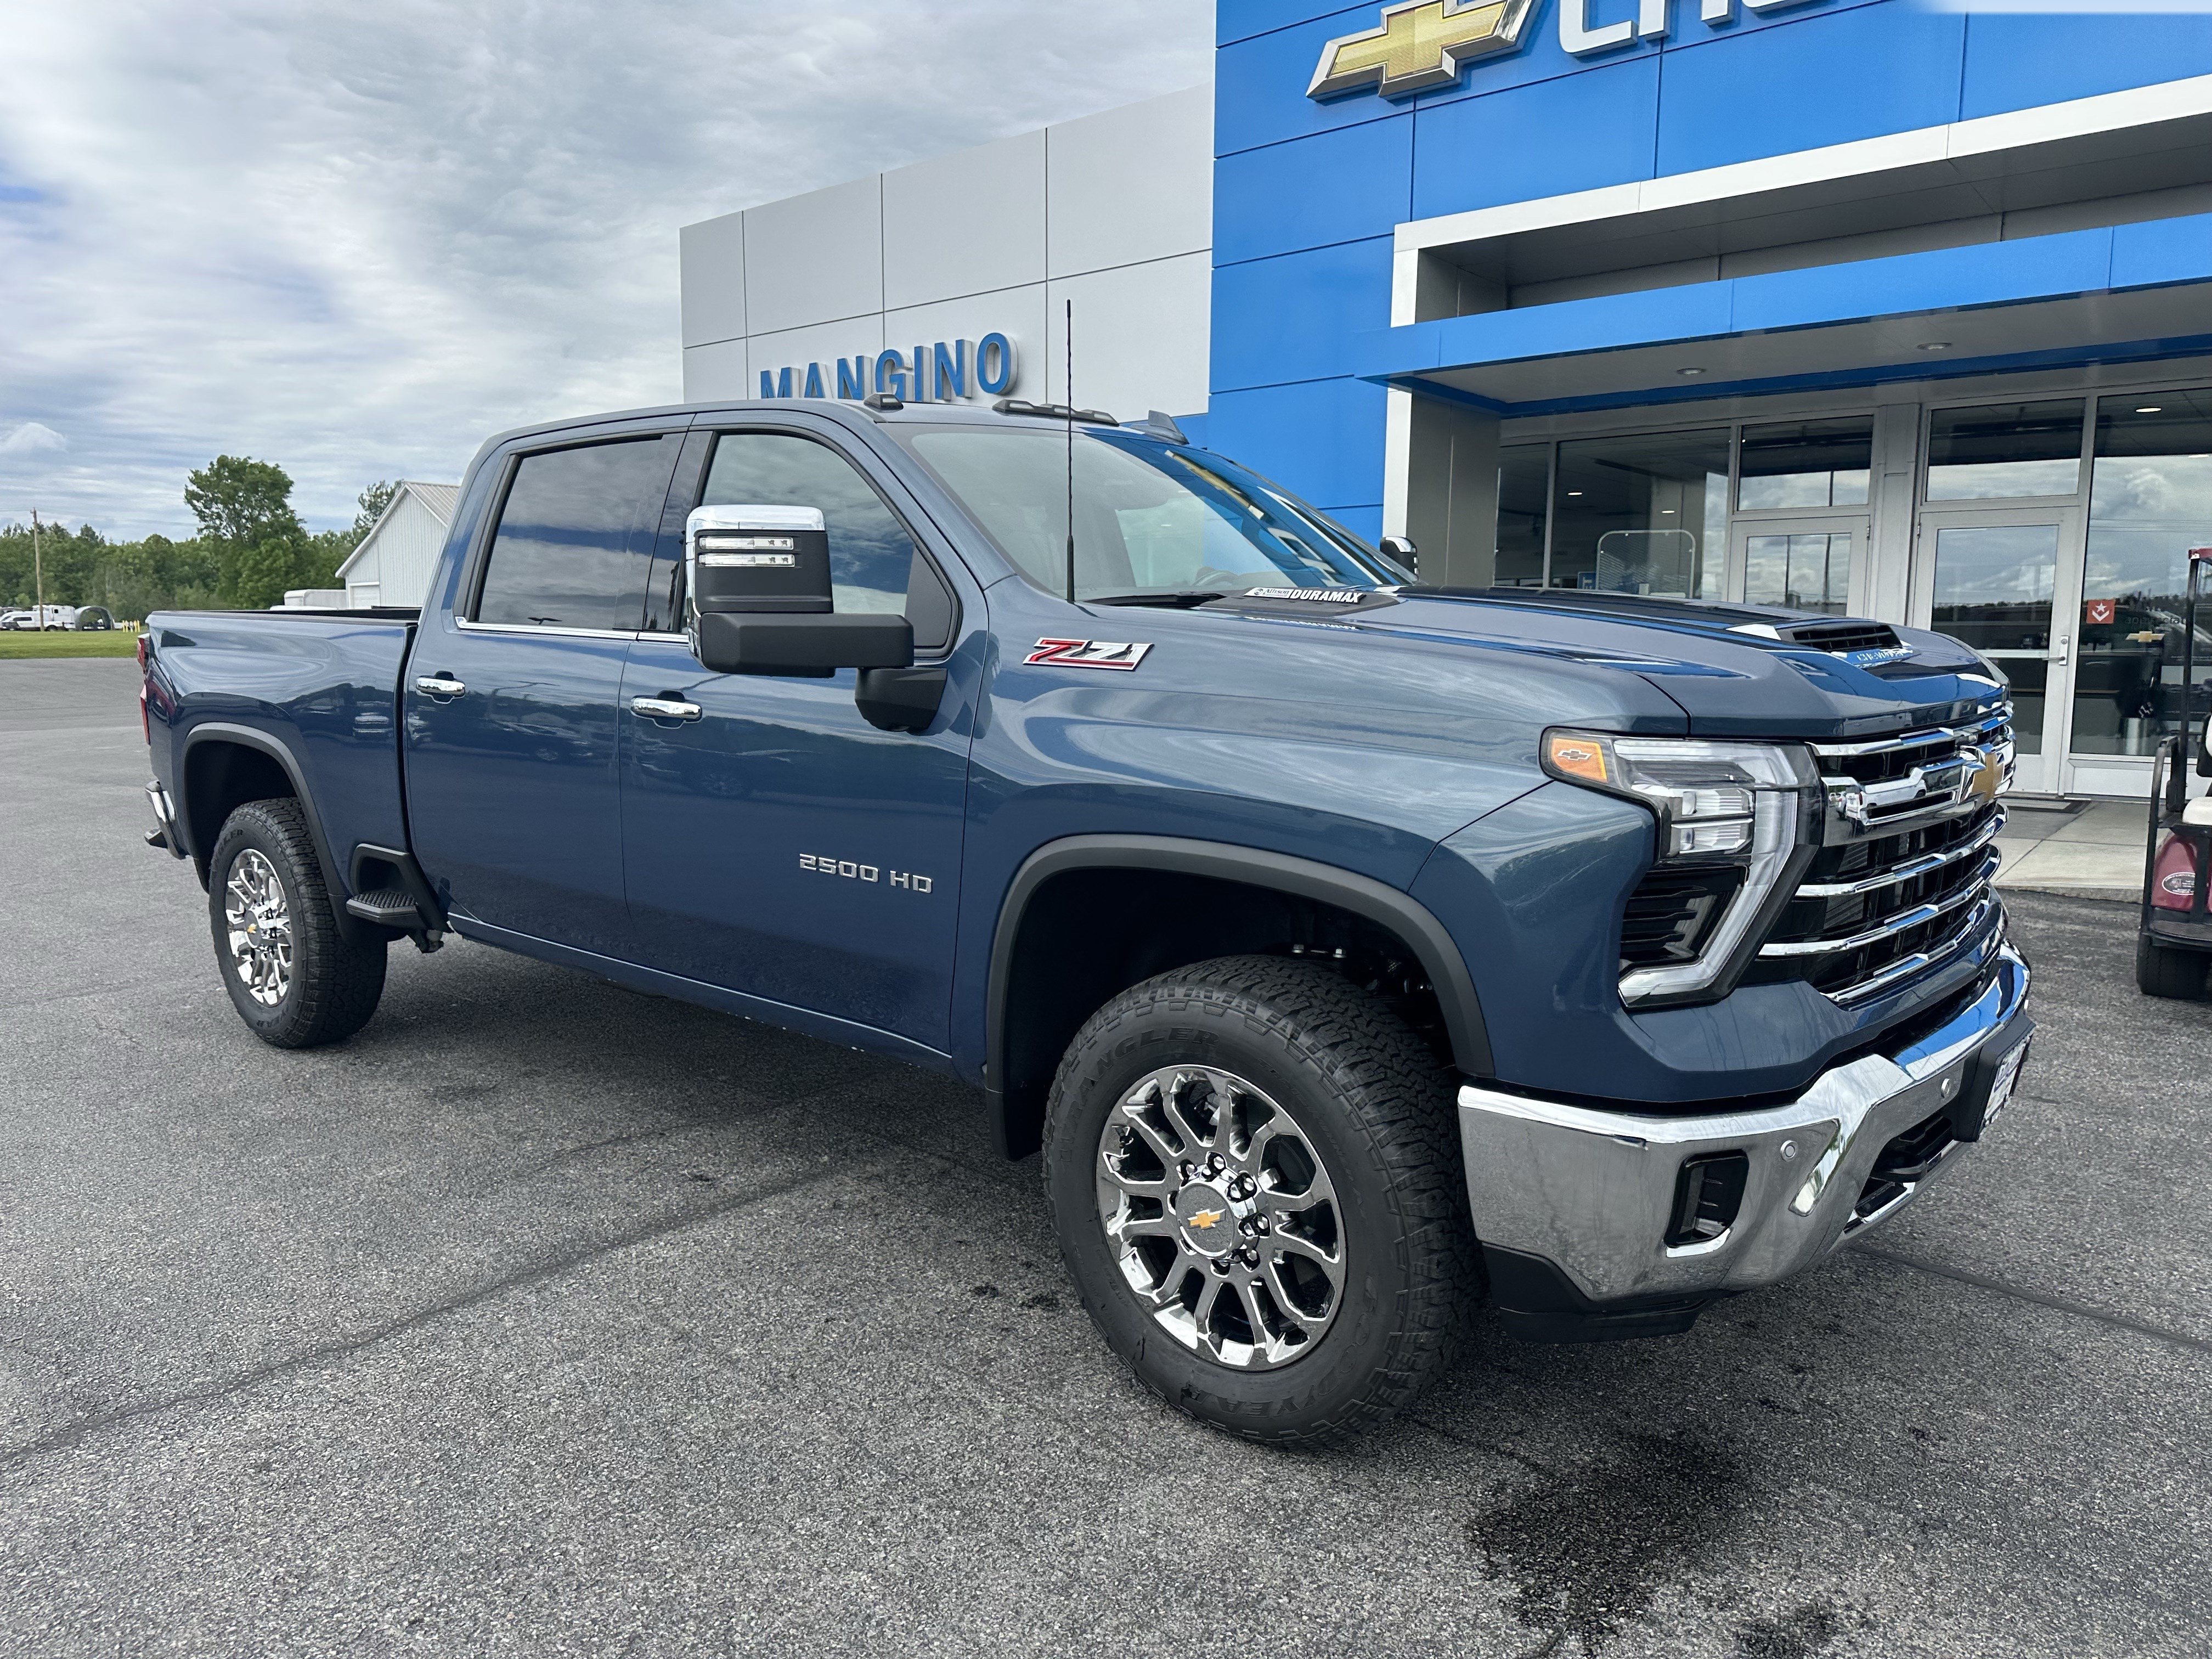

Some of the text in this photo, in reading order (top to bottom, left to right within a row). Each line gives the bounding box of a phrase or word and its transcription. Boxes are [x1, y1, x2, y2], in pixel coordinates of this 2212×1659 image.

[760, 332, 1016, 402] MANGINO
[1290, 589, 1363, 603] DURAMAX
[1023, 637, 1155, 671] Z71
[799, 853, 932, 893] 2500 HD
